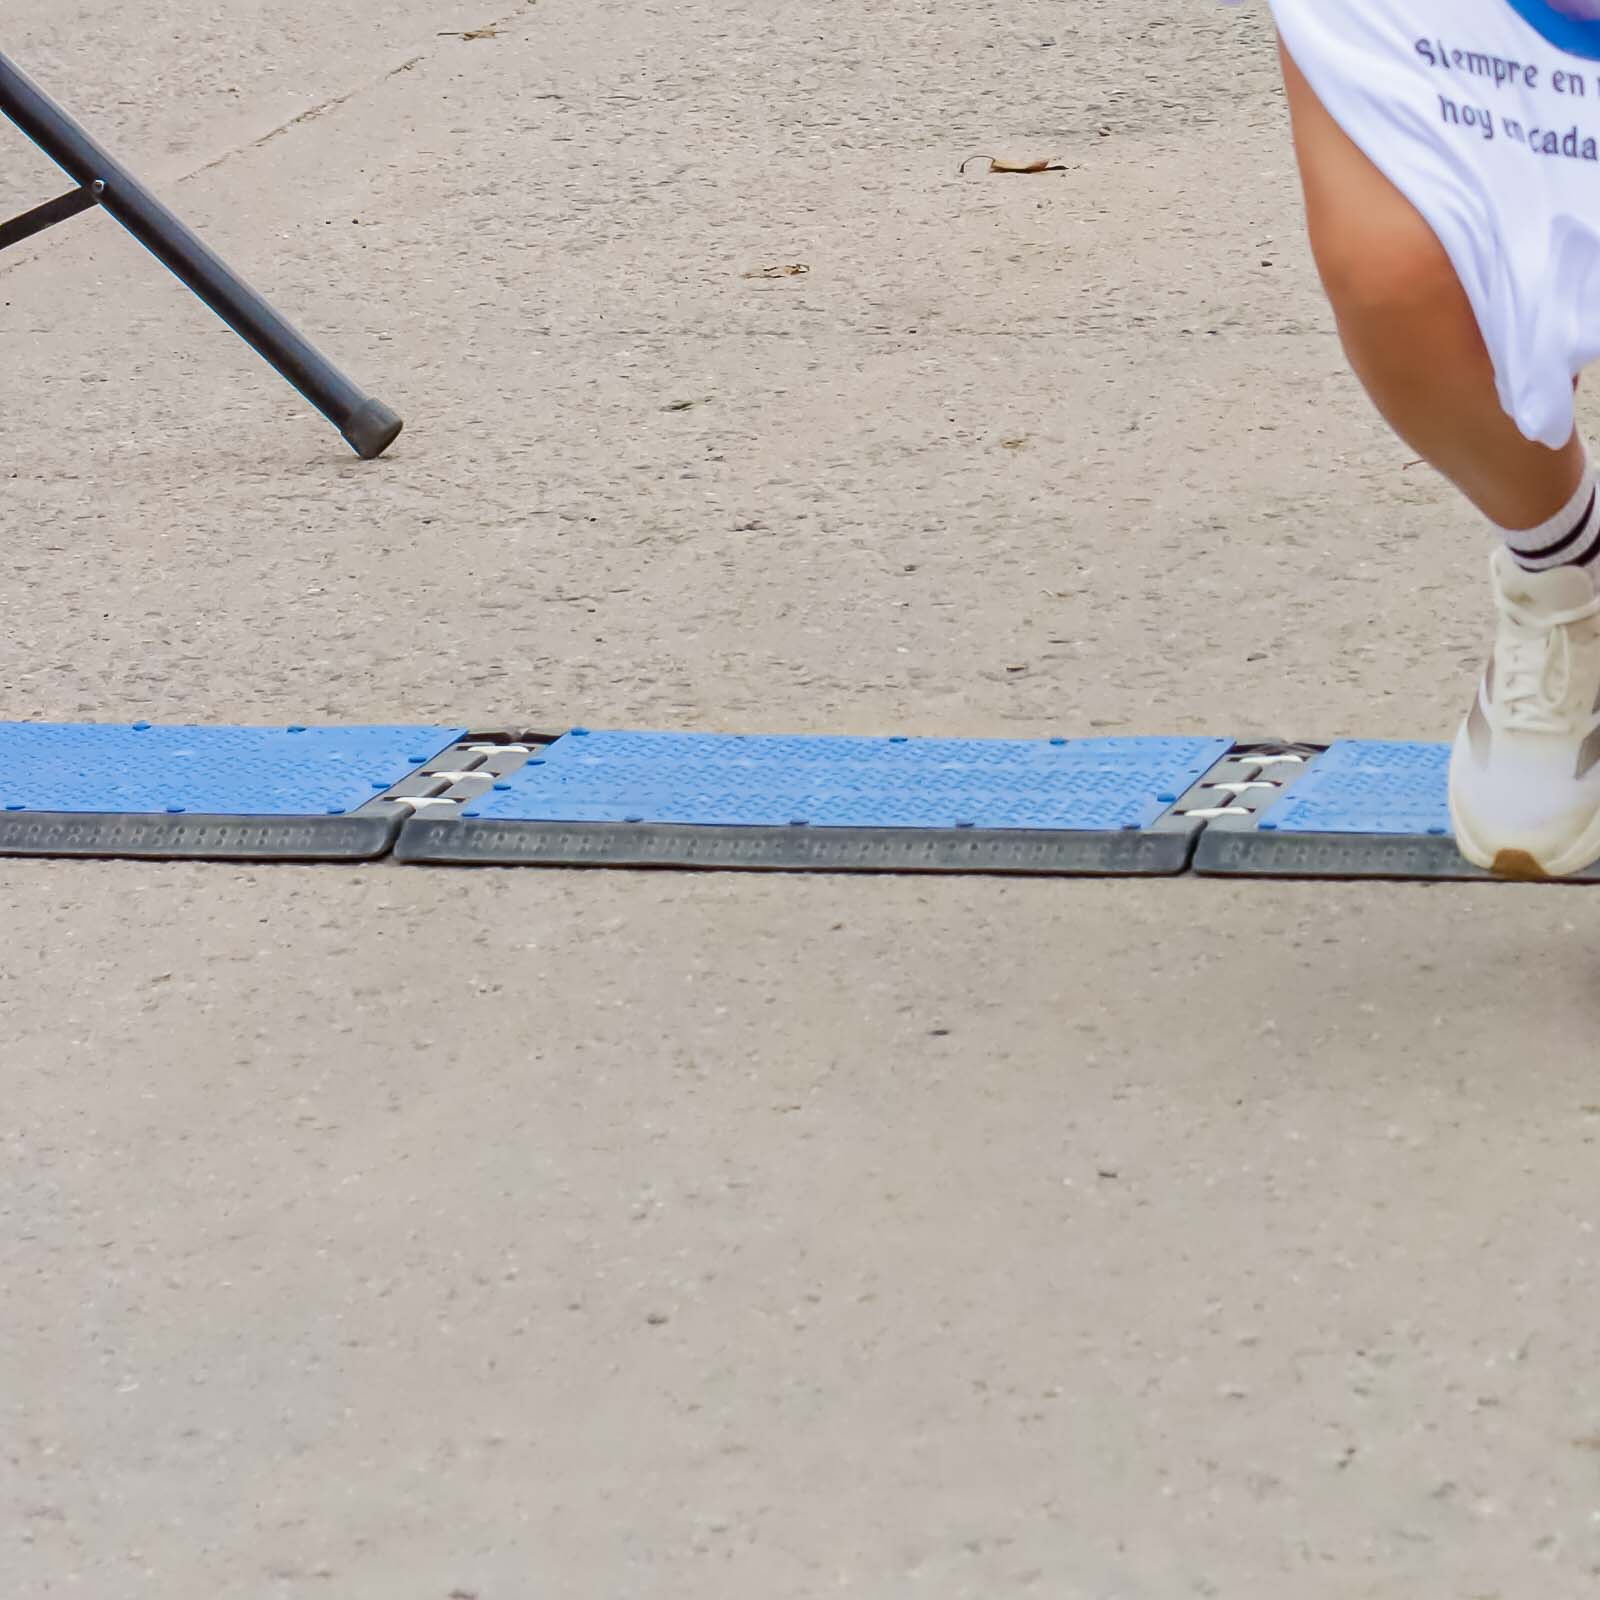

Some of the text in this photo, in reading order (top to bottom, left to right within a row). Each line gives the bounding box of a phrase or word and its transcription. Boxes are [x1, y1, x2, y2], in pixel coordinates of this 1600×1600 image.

[1414, 38, 1539, 89] Siempre
[1552, 69, 1585, 98] en
[1528, 125, 1599, 162] cada
